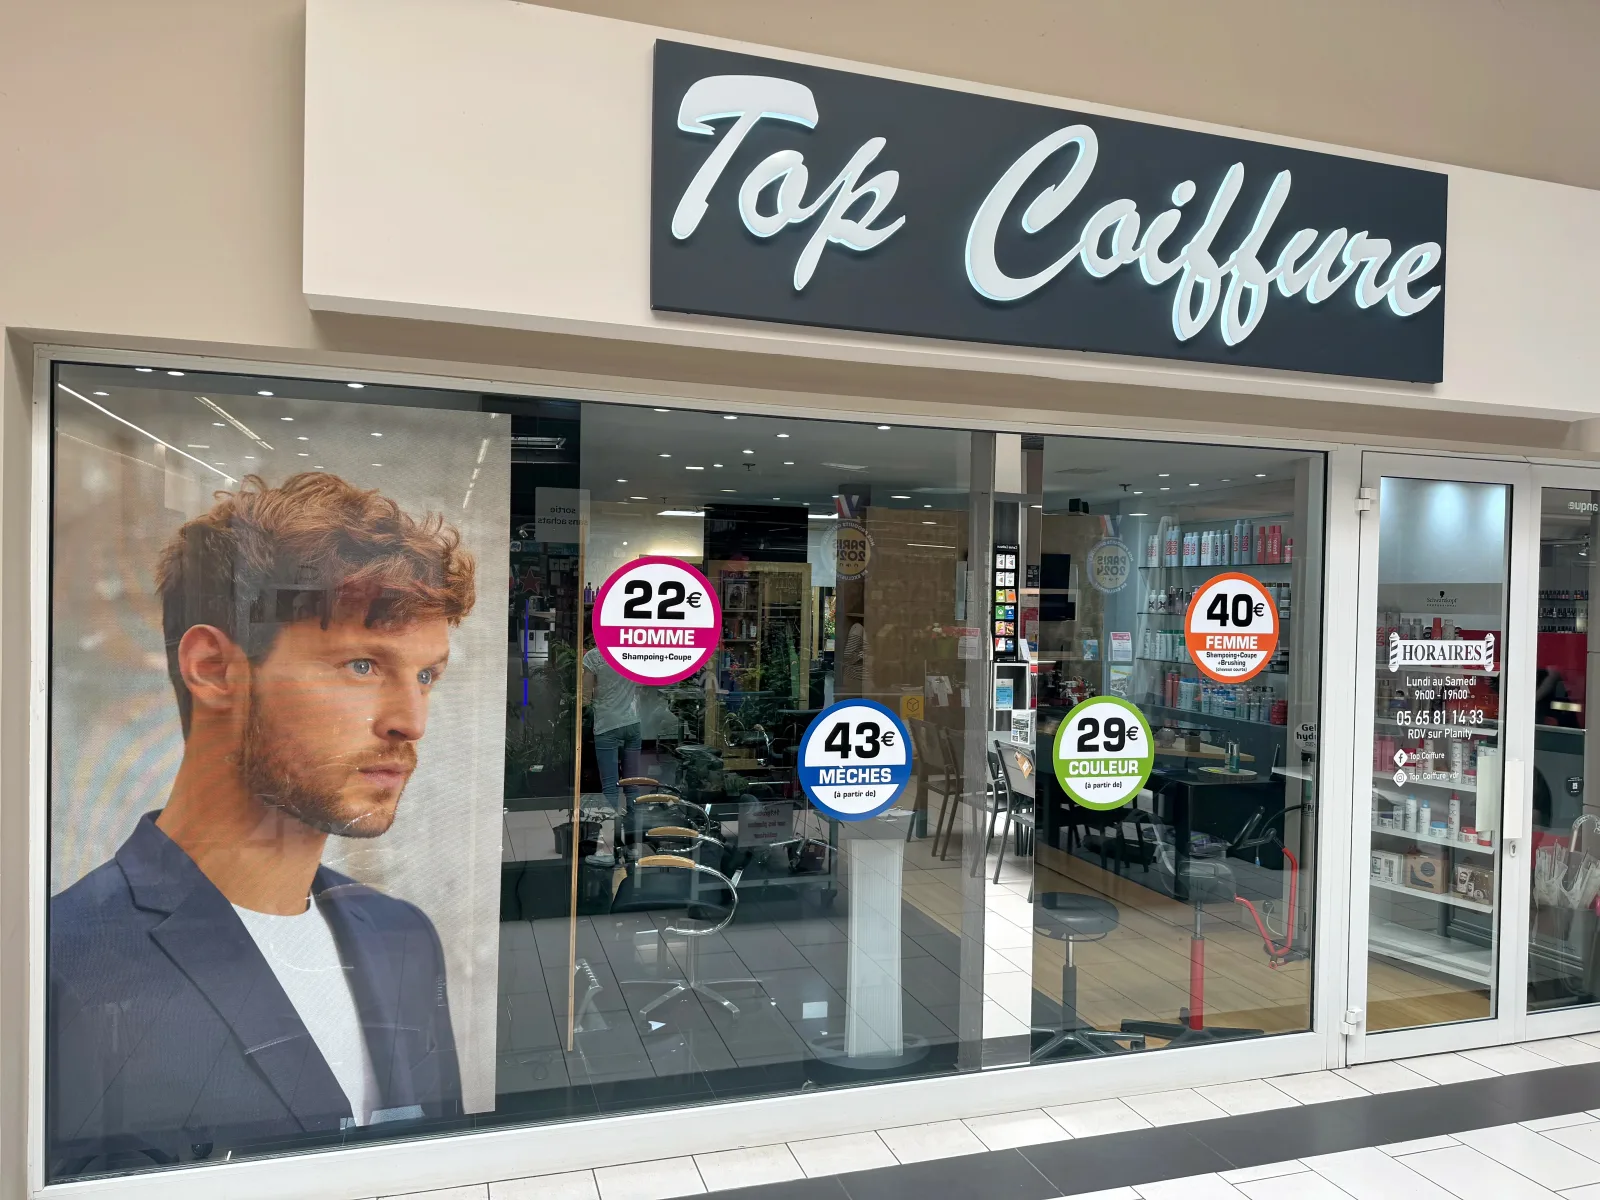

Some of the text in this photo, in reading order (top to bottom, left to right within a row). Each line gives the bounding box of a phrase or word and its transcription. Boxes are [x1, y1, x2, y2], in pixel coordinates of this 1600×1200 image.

[672, 75, 1443, 347] Top Coiffure
[624, 579, 703, 620] 22€
[1206, 593, 1265, 628] 40€
[619, 628, 695, 646] HOMME
[1205, 635, 1258, 650] FEMME
[621, 652, 692, 662] Shampoing+Coupe
[1206, 651, 1258, 660] Shampoing+Coupe
[1402, 644, 1482, 661] HORAIRES
[1406, 676, 1431, 686] Lundi
[1444, 676, 1477, 686] Samedi
[1414, 690, 1435, 700] 9h00
[1443, 689, 1468, 700] 19h00
[1396, 709, 1484, 726] 05 65 81 14 33
[824, 721, 896, 759] 43€
[1077, 717, 1139, 752] 29€
[1408, 728, 1473, 739] RDV sur Planity
[1410, 752, 1420, 760] Top
[1421, 751, 1445, 760] Coiffure
[819, 765, 892, 785] MÈCHES
[1068, 760, 1139, 776] COULEUR
[1084, 780, 1122, 790] (à partir de)
[833, 789, 877, 800] (à partir de)
